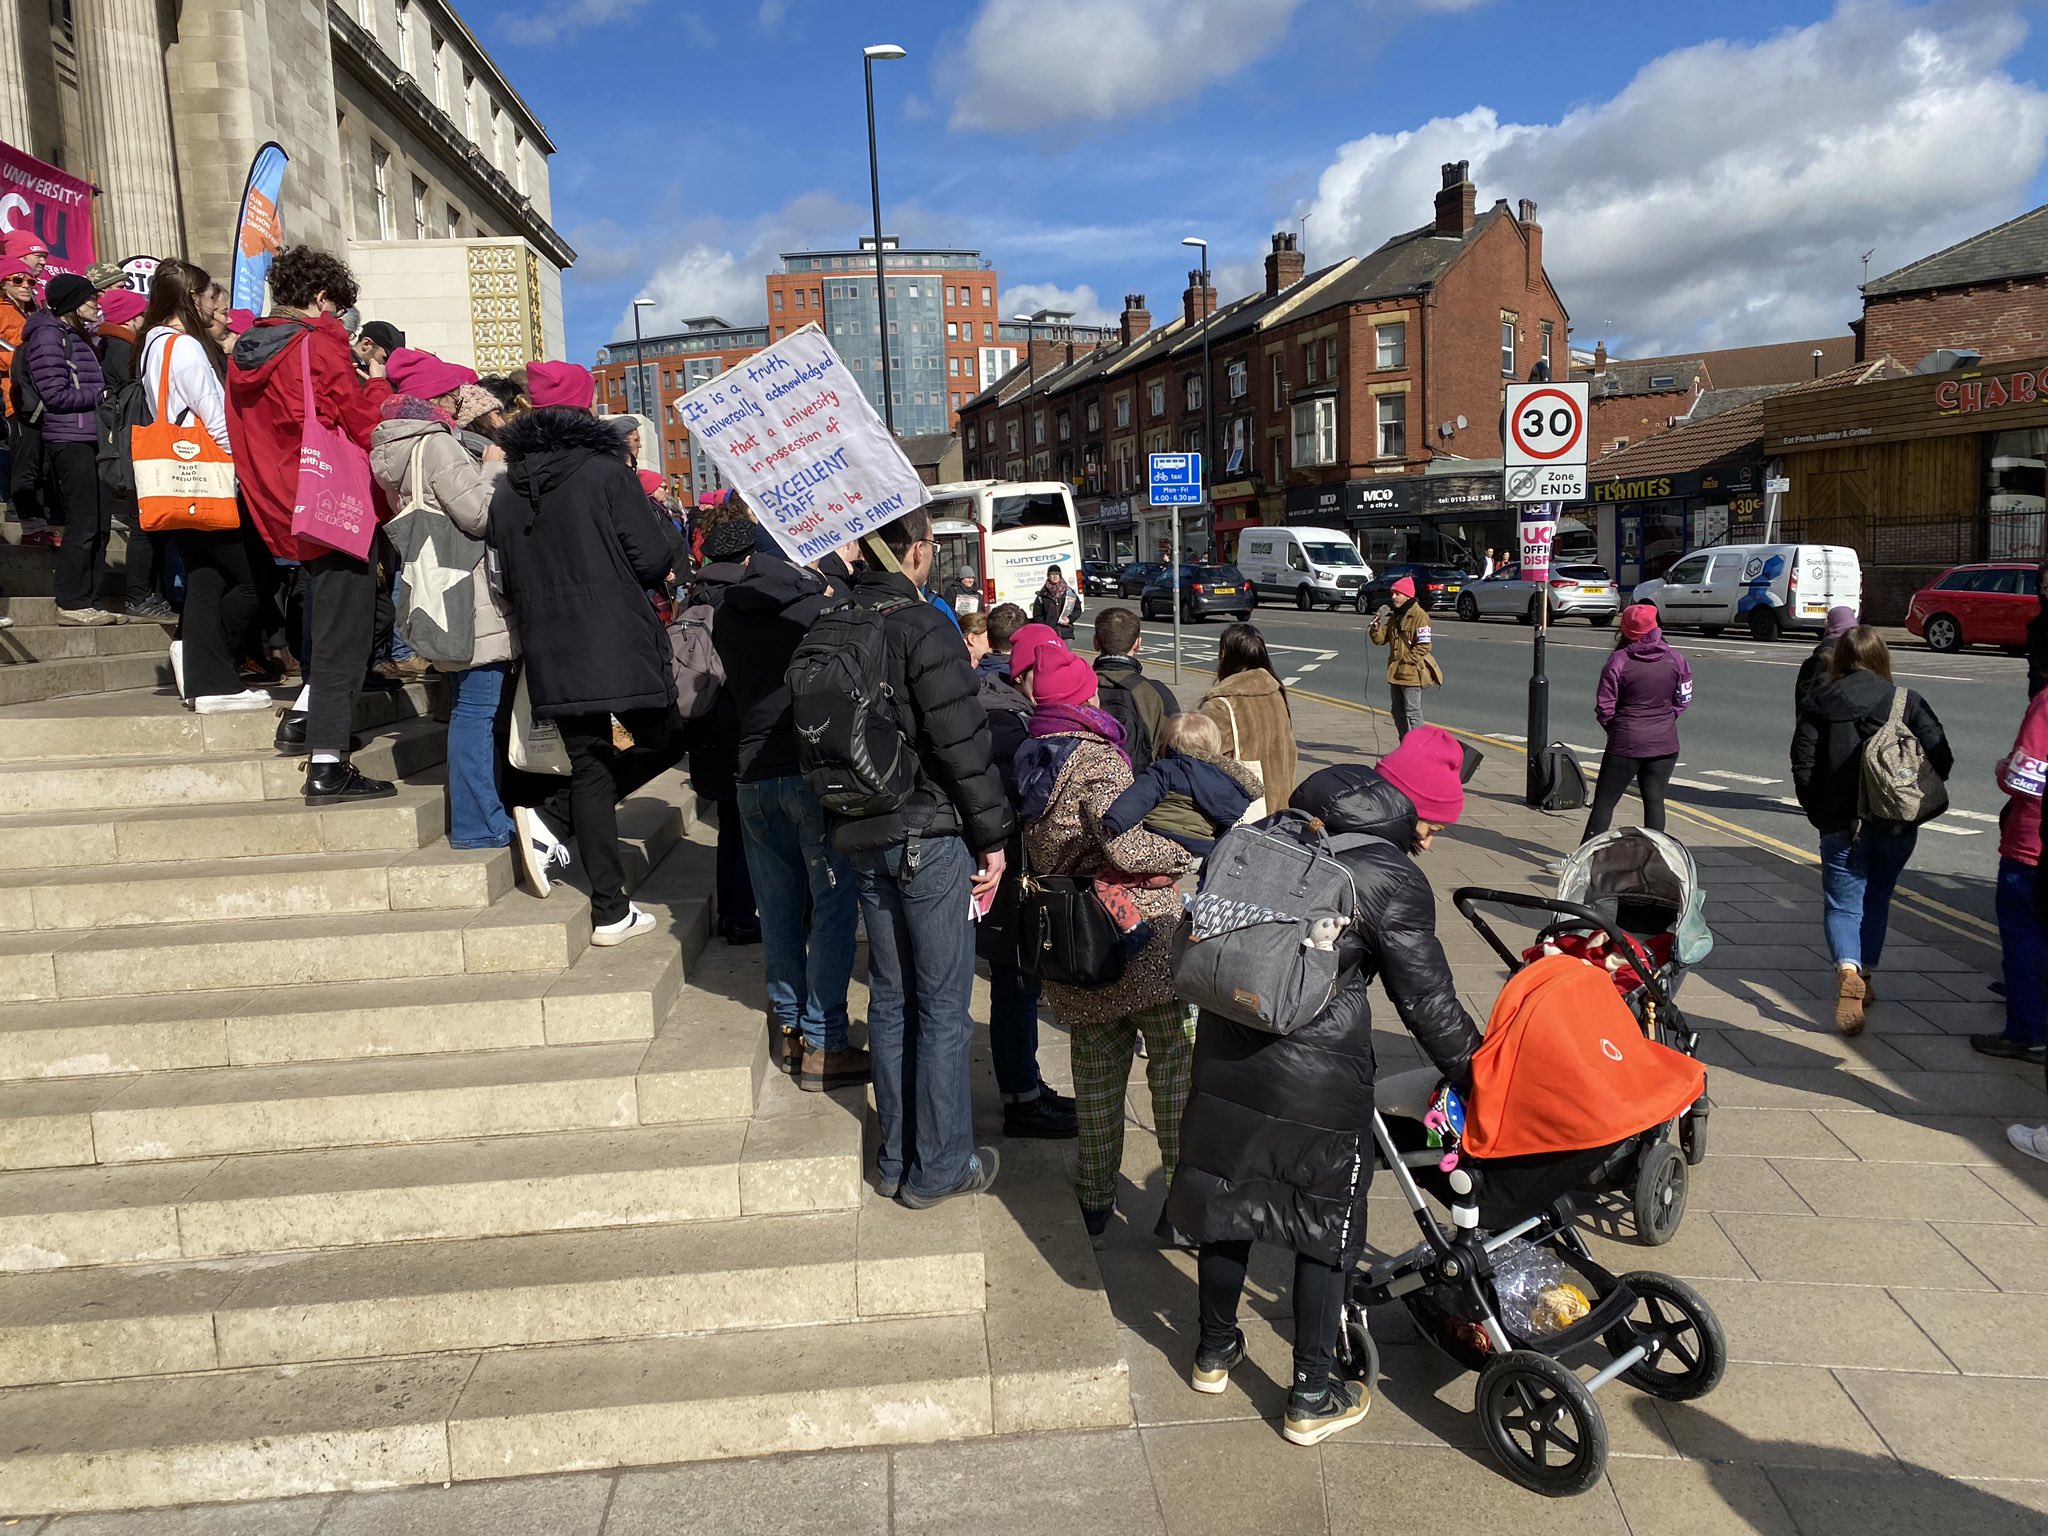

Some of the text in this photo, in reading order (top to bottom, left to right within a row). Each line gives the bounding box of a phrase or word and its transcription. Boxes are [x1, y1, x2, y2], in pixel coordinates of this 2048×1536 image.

[3, 163, 84, 207] UNIVERSITY
[249, 193, 263, 208] OUR
[247, 210, 255, 219] IS
[248, 201, 273, 224] CAMP
[682, 354, 790, 422] It is a truth
[702, 351, 834, 439] universally acknowledged
[730, 389, 840, 458] that a university
[1522, 408, 1572, 438] 30
[747, 416, 841, 474] in possession of
[1783, 437, 1794, 445] Eat
[1795, 434, 1815, 444] Fresh,
[1817, 431, 1841, 441] Healthy
[1849, 427, 1872, 437] Grilled
[300, 447, 320, 458] Host
[300, 456, 318, 466] with
[759, 446, 850, 510] EXCELLENT
[1513, 477, 1533, 490] 20
[1548, 472, 1574, 481] Zone
[1541, 483, 1582, 495] ENDS
[1594, 478, 1671, 501] FLAMES
[774, 490, 816, 524] STAFF
[788, 490, 864, 537] ought to be
[1100, 501, 1120, 517] Brunch
[1375, 501, 1387, 509] city
[797, 493, 905, 560] PAYING US FAIRLY
[1005, 554, 1057, 565] HUNTERS
